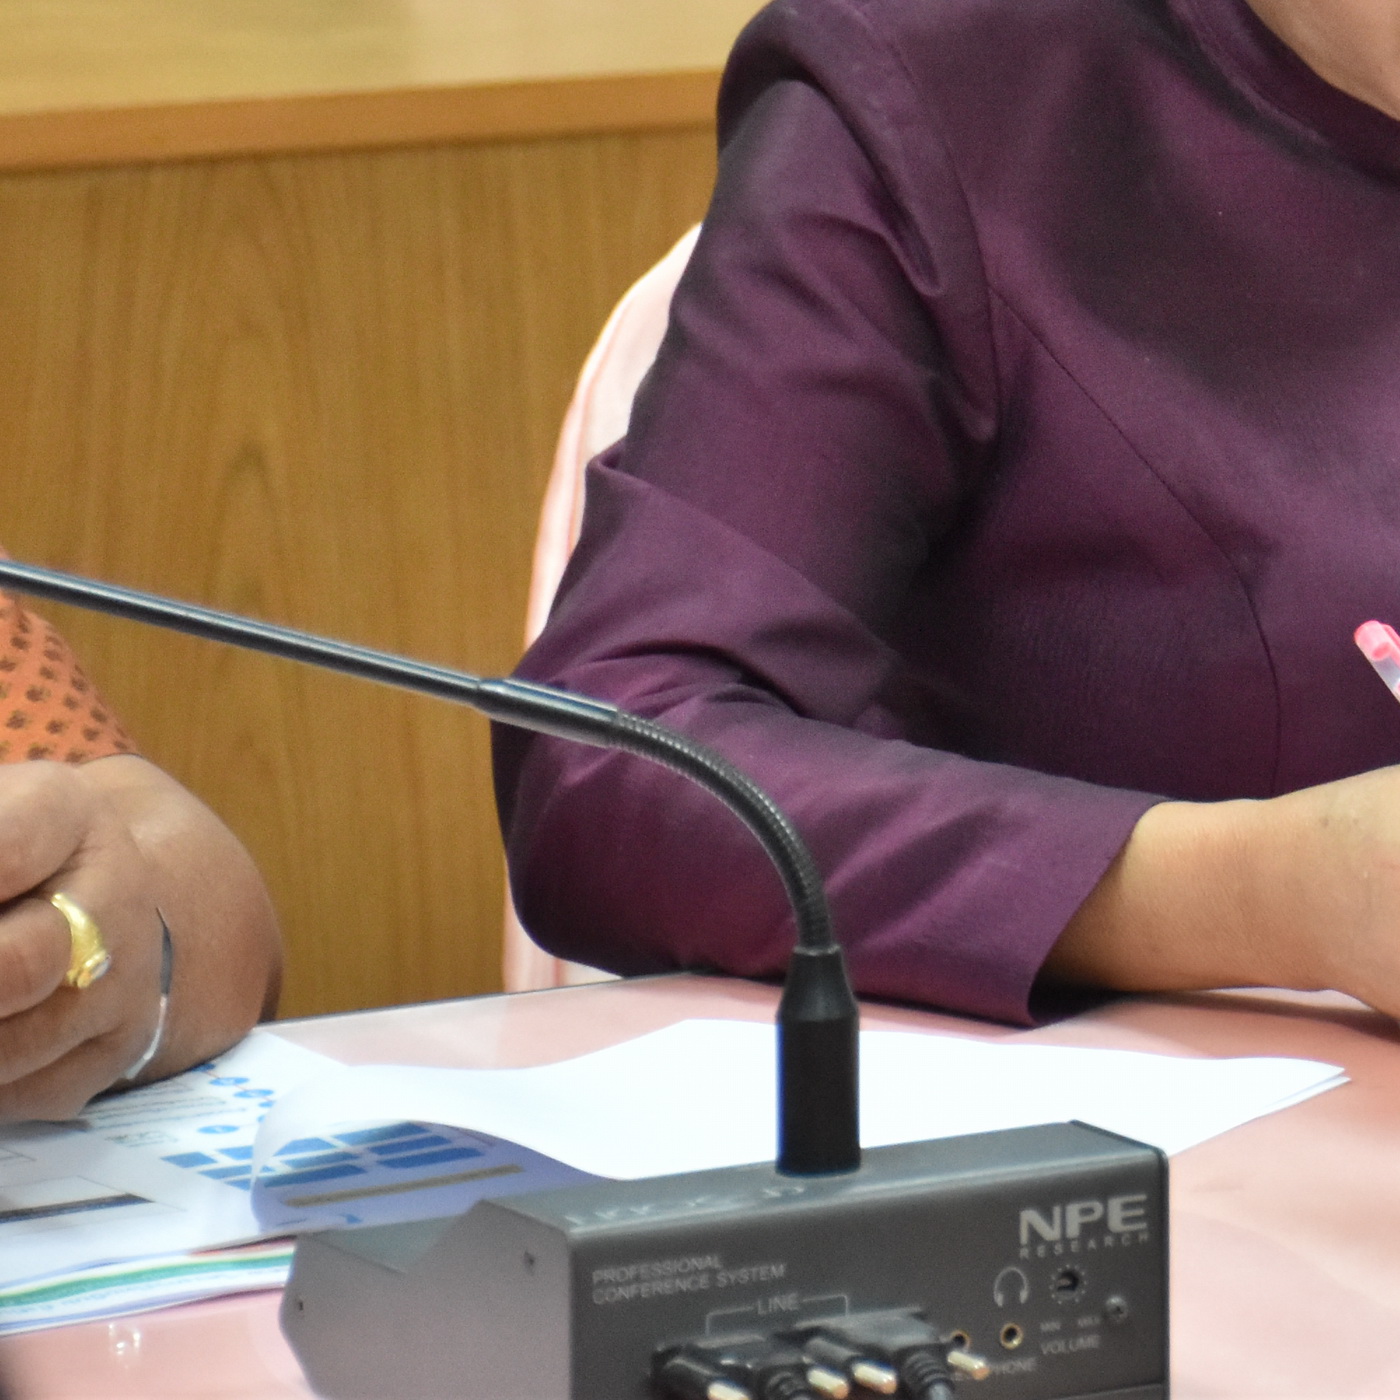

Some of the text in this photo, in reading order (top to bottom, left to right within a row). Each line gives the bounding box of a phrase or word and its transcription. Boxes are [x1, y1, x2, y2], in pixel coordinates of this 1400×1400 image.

[1019, 1194, 1148, 1245] NPE
[1019, 1232, 1149, 1259] RESEARCH
[592, 1255, 721, 1285] PROFESSIONAL
[592, 1263, 786, 1304] CONFERENCE SYSTEM
[757, 1293, 799, 1315] LINE
[1041, 1334, 1101, 1355] VOLUME
